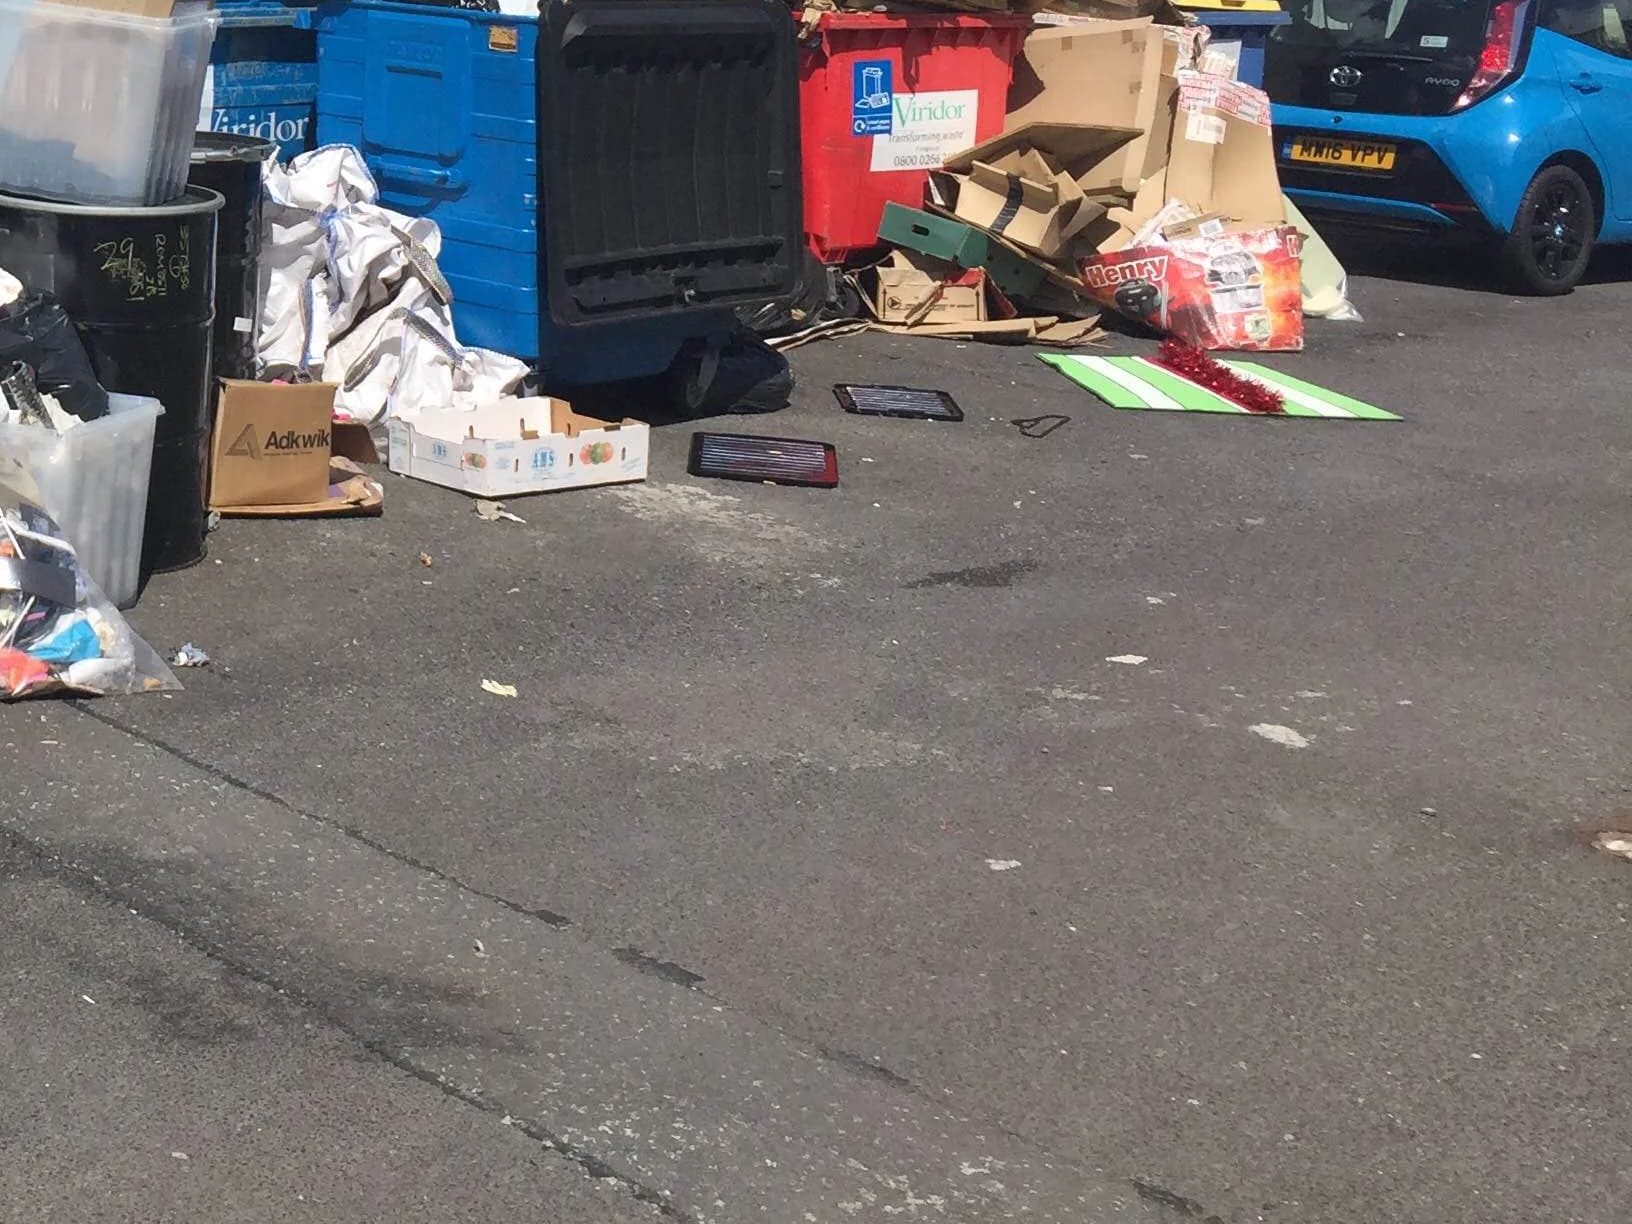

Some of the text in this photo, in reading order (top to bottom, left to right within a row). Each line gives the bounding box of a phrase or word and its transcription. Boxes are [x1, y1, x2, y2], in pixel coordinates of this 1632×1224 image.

[893, 97, 966, 128] Viridor
[893, 155, 917, 166] 0800
[1350, 144, 1388, 164] VPV
[1085, 256, 1168, 288] Henry
[264, 429, 330, 450] Adkwik
